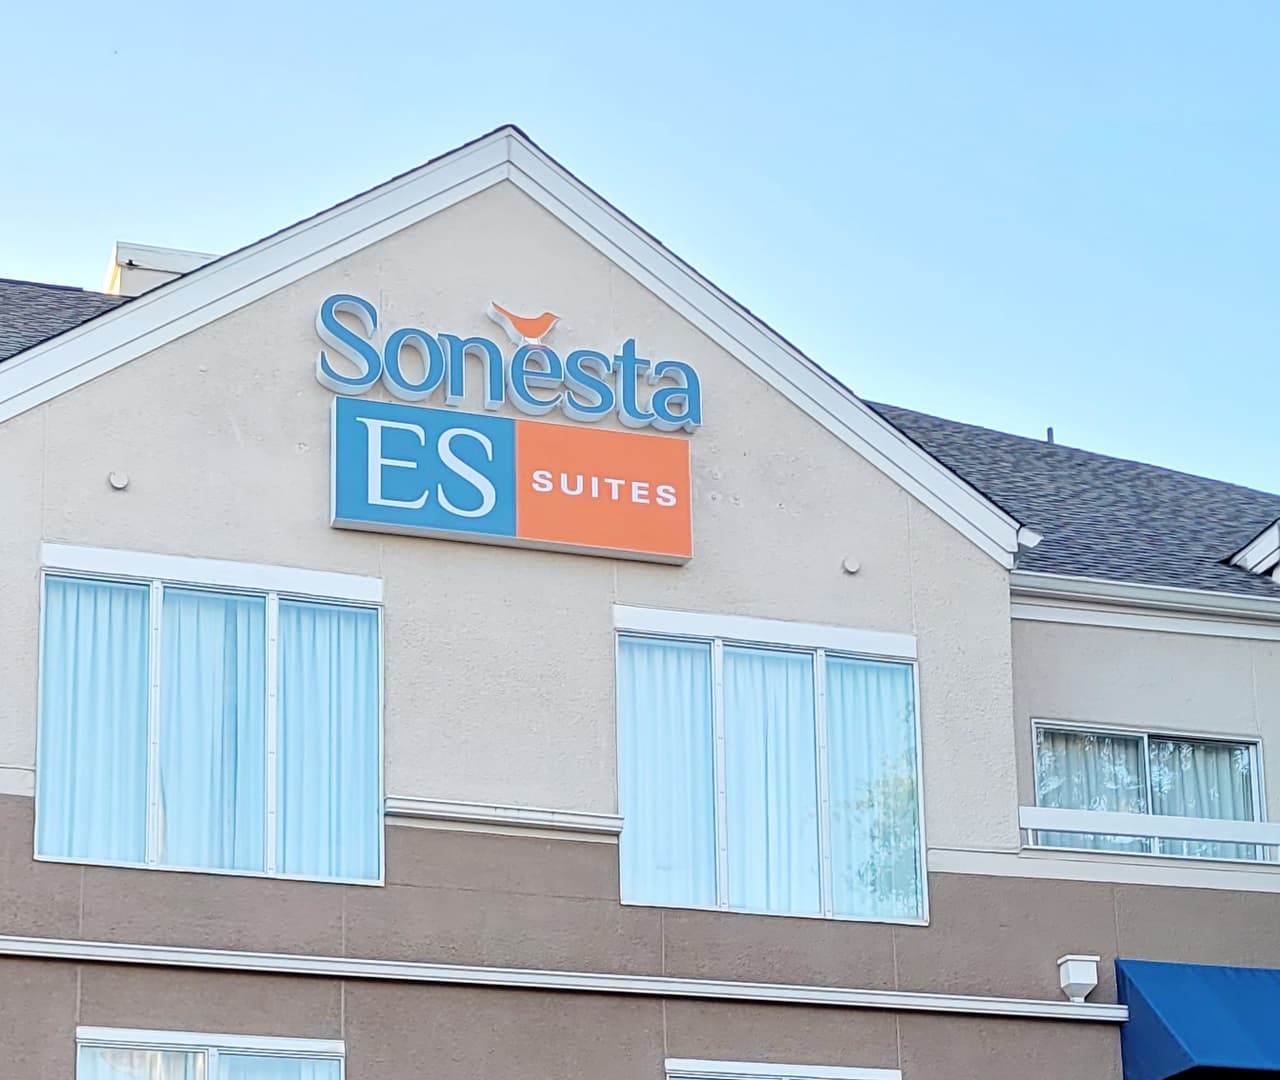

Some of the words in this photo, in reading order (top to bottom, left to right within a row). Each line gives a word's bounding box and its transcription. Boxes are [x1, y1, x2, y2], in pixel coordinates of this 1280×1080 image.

[317, 292, 702, 431] Sonesta
[355, 416, 497, 518] ES
[531, 469, 678, 507] SUITES
